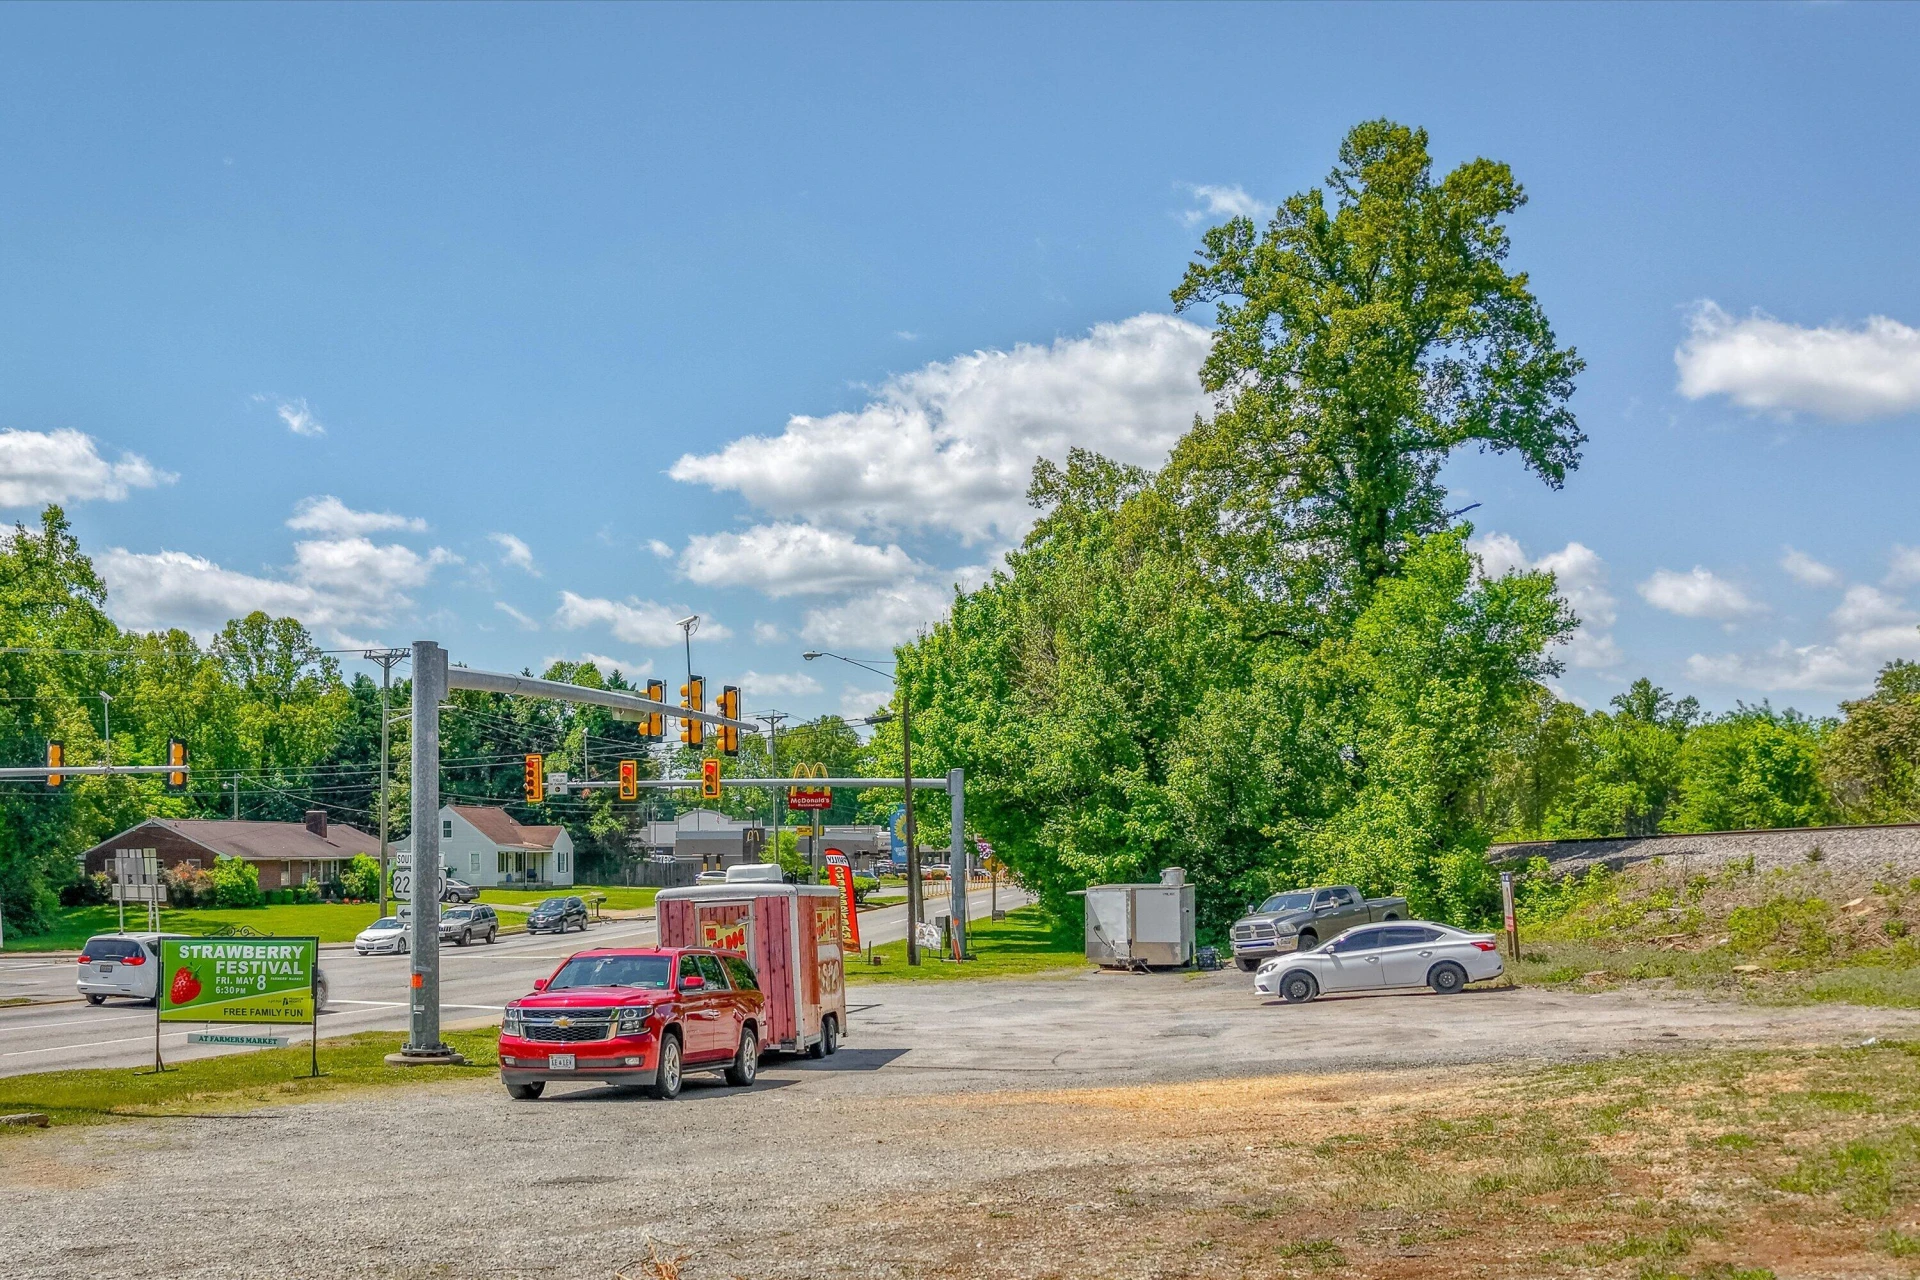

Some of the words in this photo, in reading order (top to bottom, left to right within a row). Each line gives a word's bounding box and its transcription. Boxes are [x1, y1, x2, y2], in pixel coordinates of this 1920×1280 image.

[394, 875, 411, 894] 22
[179, 945, 305, 959] STRAWBERRY
[215, 961, 304, 975] FESTIVAL
[215, 976, 233, 985] FRI.
[235, 976, 255, 985] MAY
[256, 974, 267, 991] 8
[223, 1007, 247, 1016] FREE
[249, 1008, 282, 1017] FAMILY
[284, 1008, 303, 1017] FUN
[210, 1035, 245, 1044] FARMERS
[245, 1037, 278, 1045] MARKET
